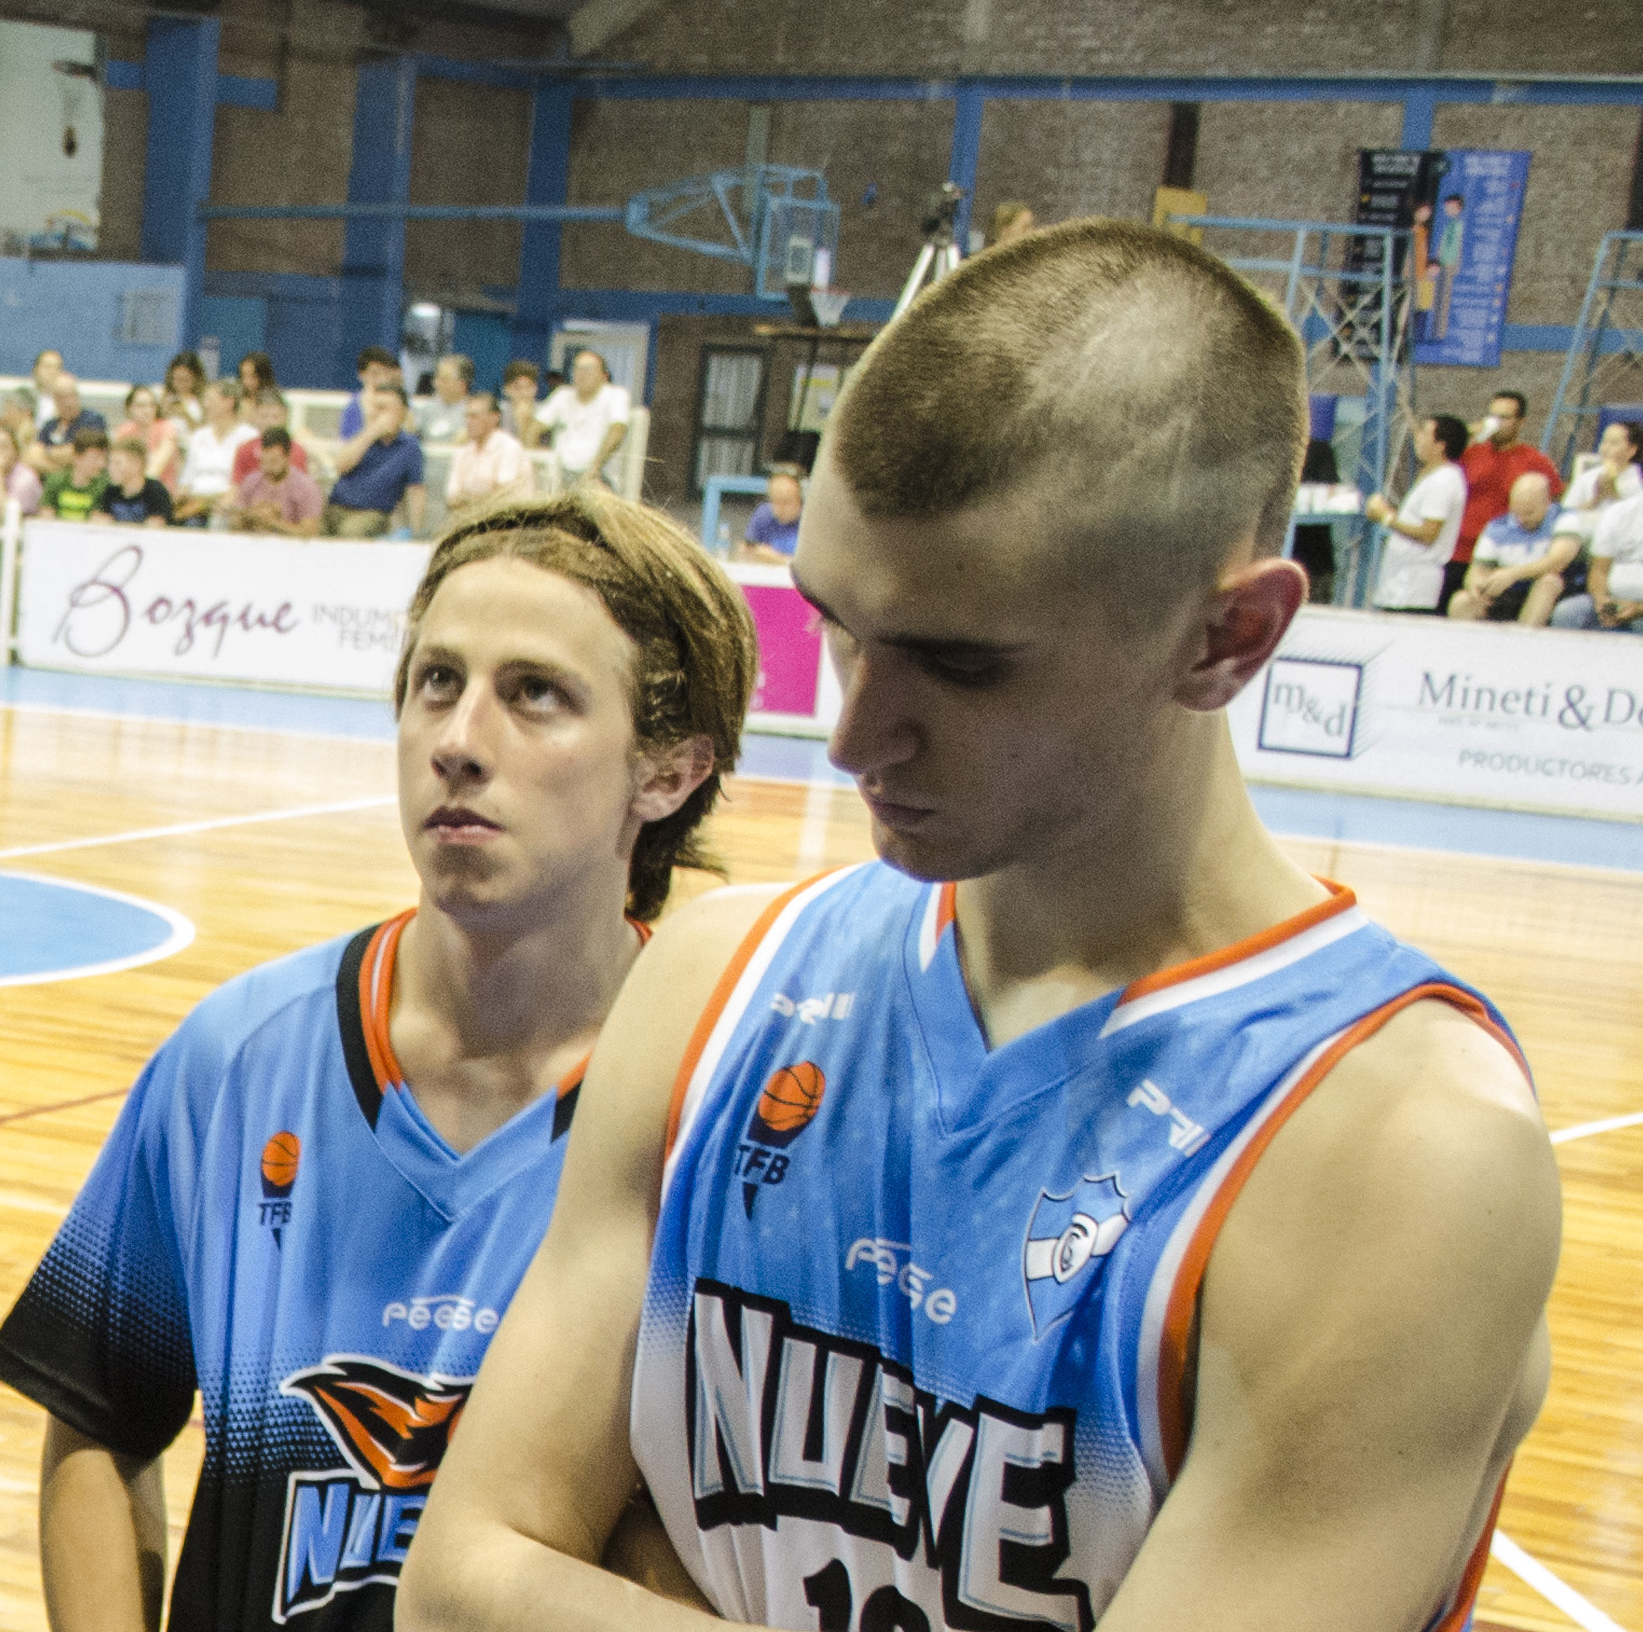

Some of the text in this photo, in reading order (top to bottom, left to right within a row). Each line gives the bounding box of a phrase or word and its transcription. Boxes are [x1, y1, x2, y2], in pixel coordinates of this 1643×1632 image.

[52, 544, 299, 659] Bozque
[312, 603, 403, 630] INDUM
[1458, 749, 1631, 786] PRODUCTORES
[732, 1143, 790, 1187] TFB
